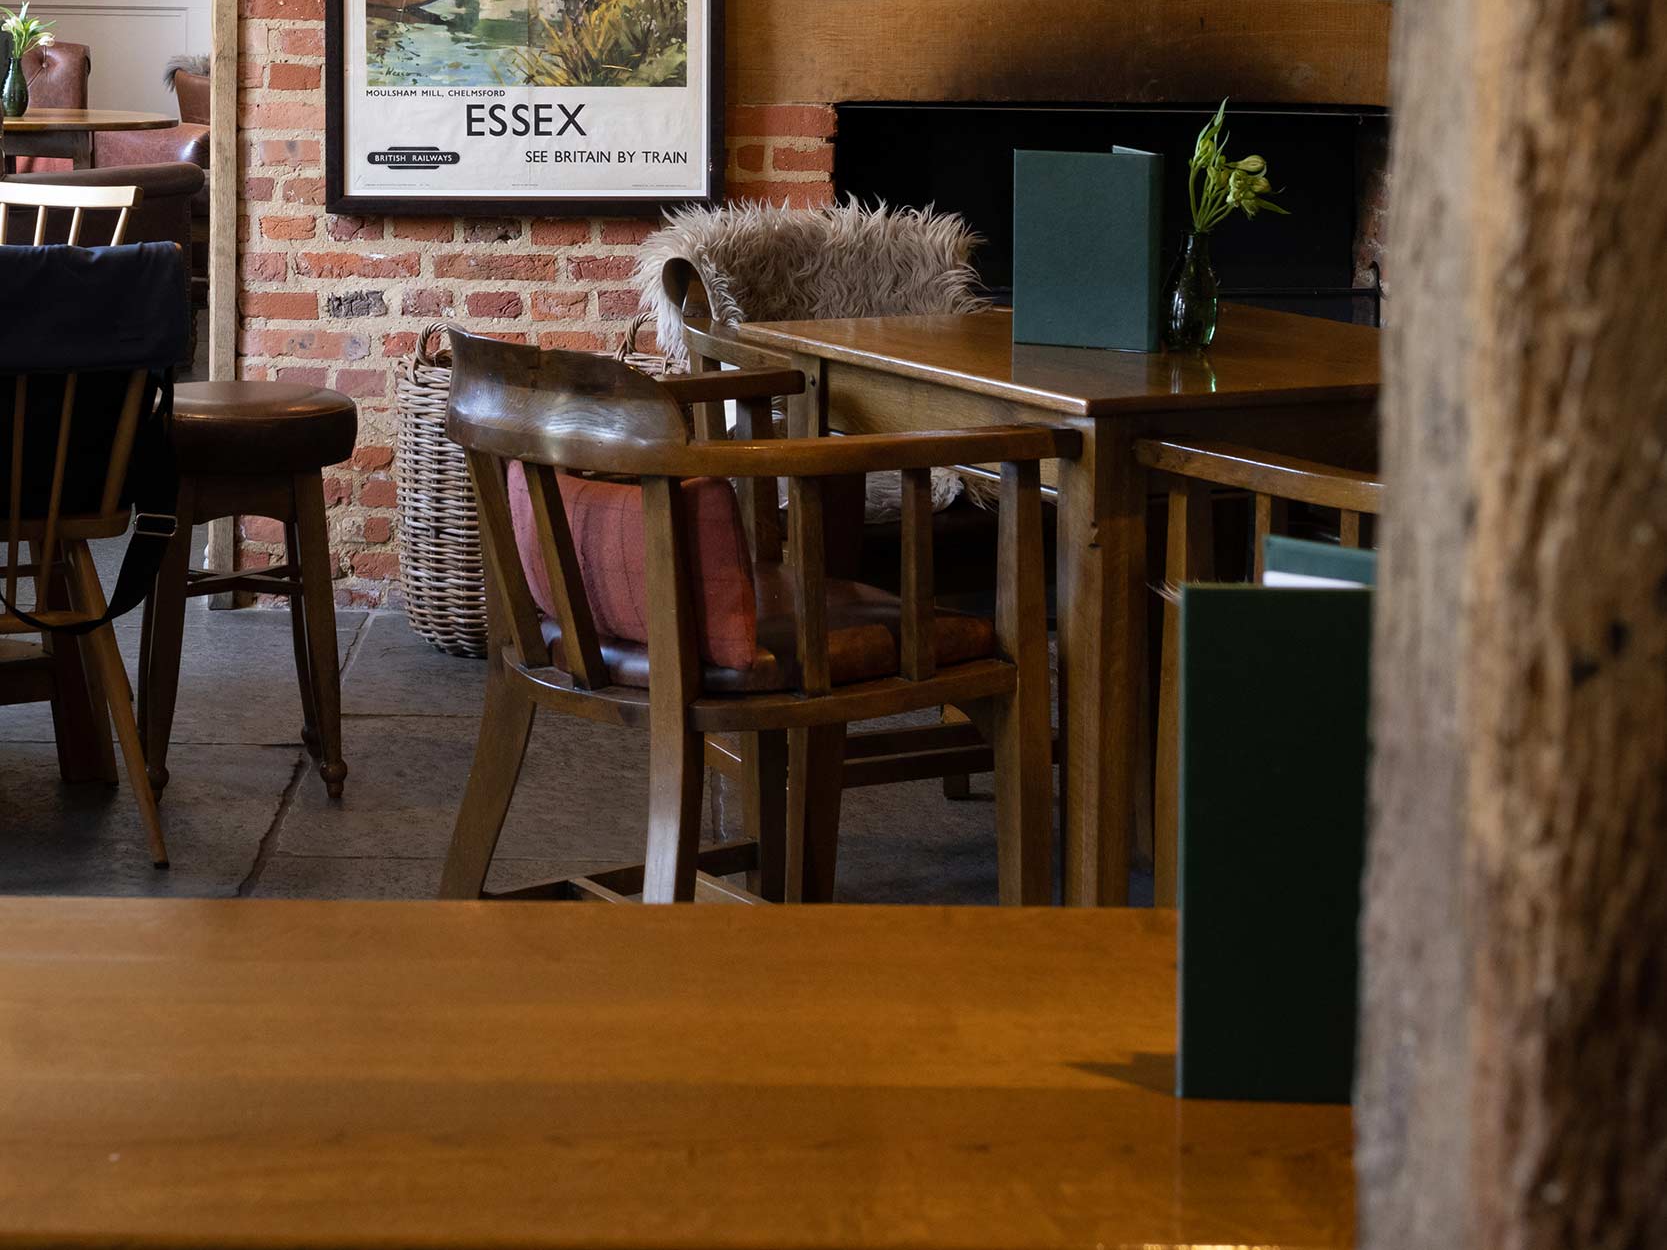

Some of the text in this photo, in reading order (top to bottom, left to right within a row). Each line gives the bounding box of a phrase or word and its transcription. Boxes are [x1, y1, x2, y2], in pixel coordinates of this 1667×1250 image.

[366, 89, 506, 98] MOULSHAM MILL, CHELMSFORD
[465, 103, 588, 138] ESSEX
[374, 154, 453, 163] BRITISH RAILWAYS
[525, 150, 688, 164] SEE BRITAIN BY TRAIN
